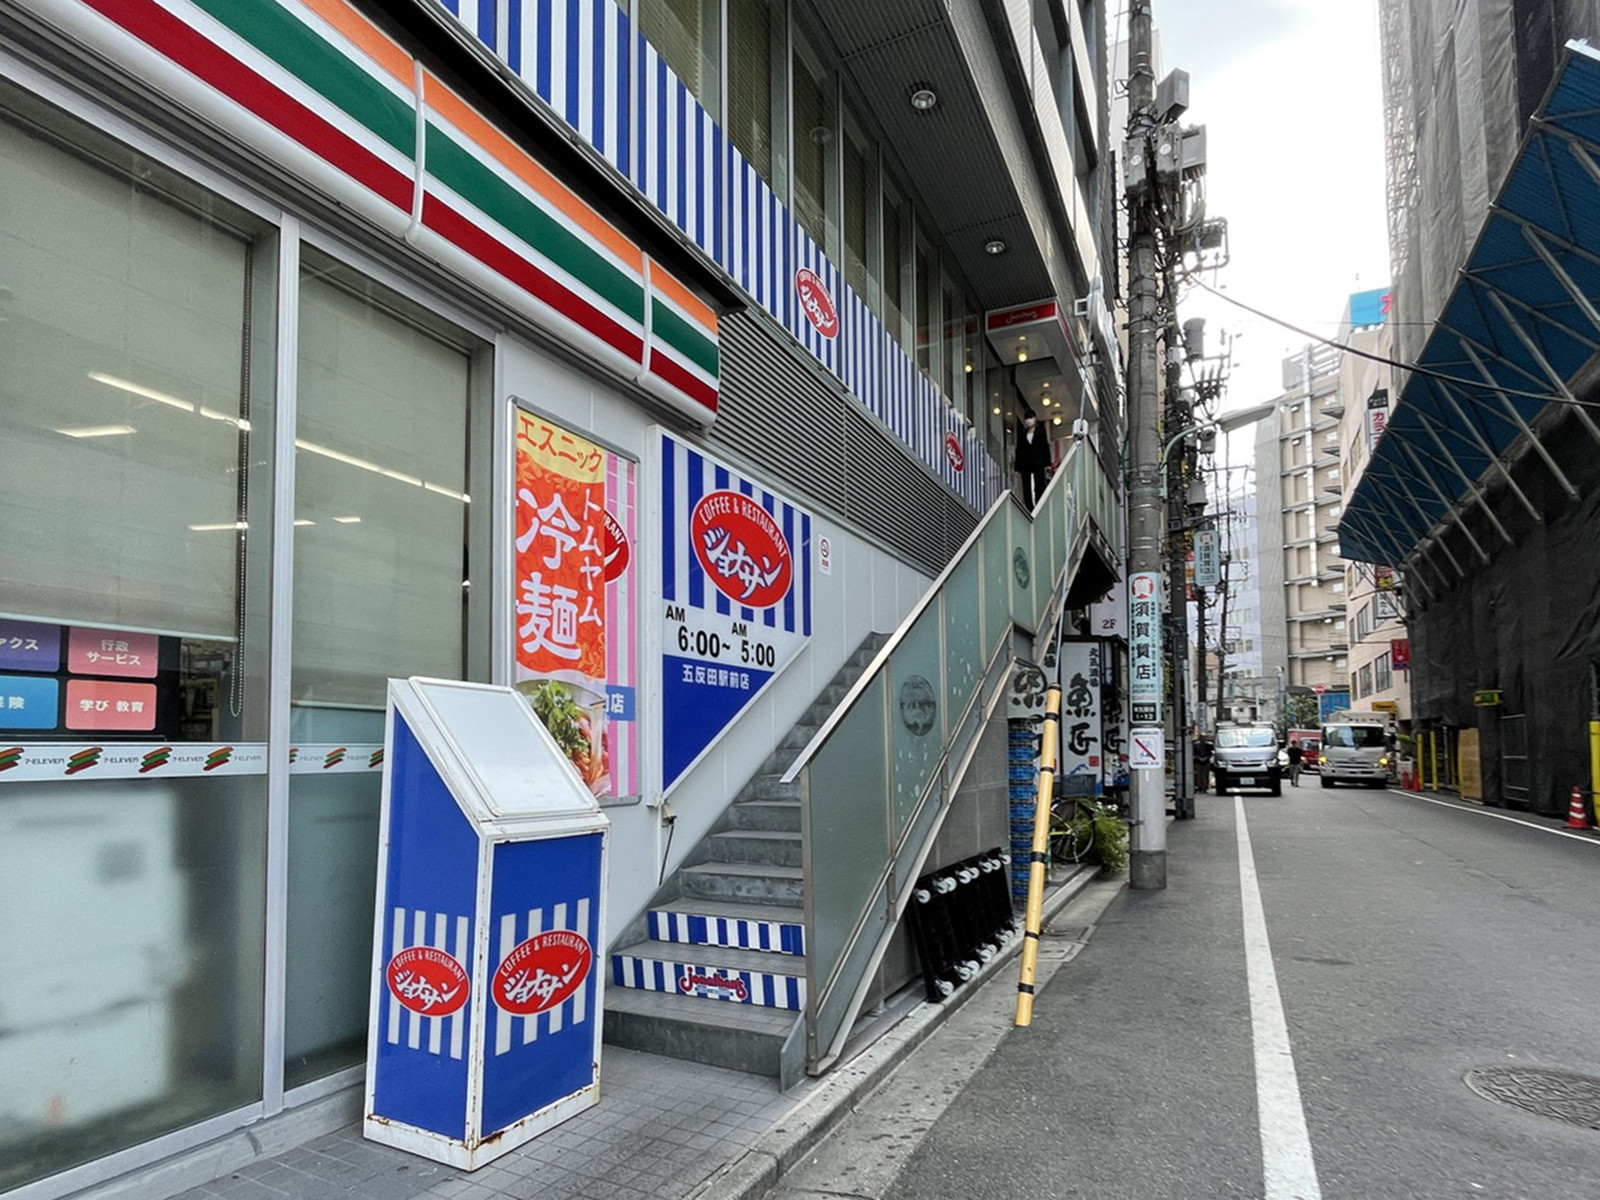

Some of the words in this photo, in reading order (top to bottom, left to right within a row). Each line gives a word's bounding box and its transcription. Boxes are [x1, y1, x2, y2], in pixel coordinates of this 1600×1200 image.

[517, 416, 602, 472] エスニック
[699, 496, 731, 525] COFFEE
[733, 497, 739, 513] &
[742, 501, 788, 557] RESTAURANT
[578, 488, 602, 626] トムヤム
[702, 526, 784, 598] ジョナサン
[516, 488, 581, 660] 冷麺
[666, 604, 685, 622] AM
[1102, 618, 1117, 630] 2F
[101, 639, 128, 652] 行政
[731, 622, 747, 638] AM
[86, 651, 141, 666] サービス
[741, 640, 775, 668] 5:00
[682, 664, 749, 690] 五反田駅前店
[80, 699, 109, 712] 学び
[116, 700, 144, 713] 教育
[392, 951, 416, 971] COFFEE
[418, 950, 423, 960] &
[425, 950, 464, 982] RESTAURANT
[500, 944, 531, 977] COFFEE
[533, 940, 540, 951] &
[542, 934, 588, 955] RESTAURANT
[395, 969, 460, 1011] ジョナサン
[503, 957, 583, 1009] ジョナサン
